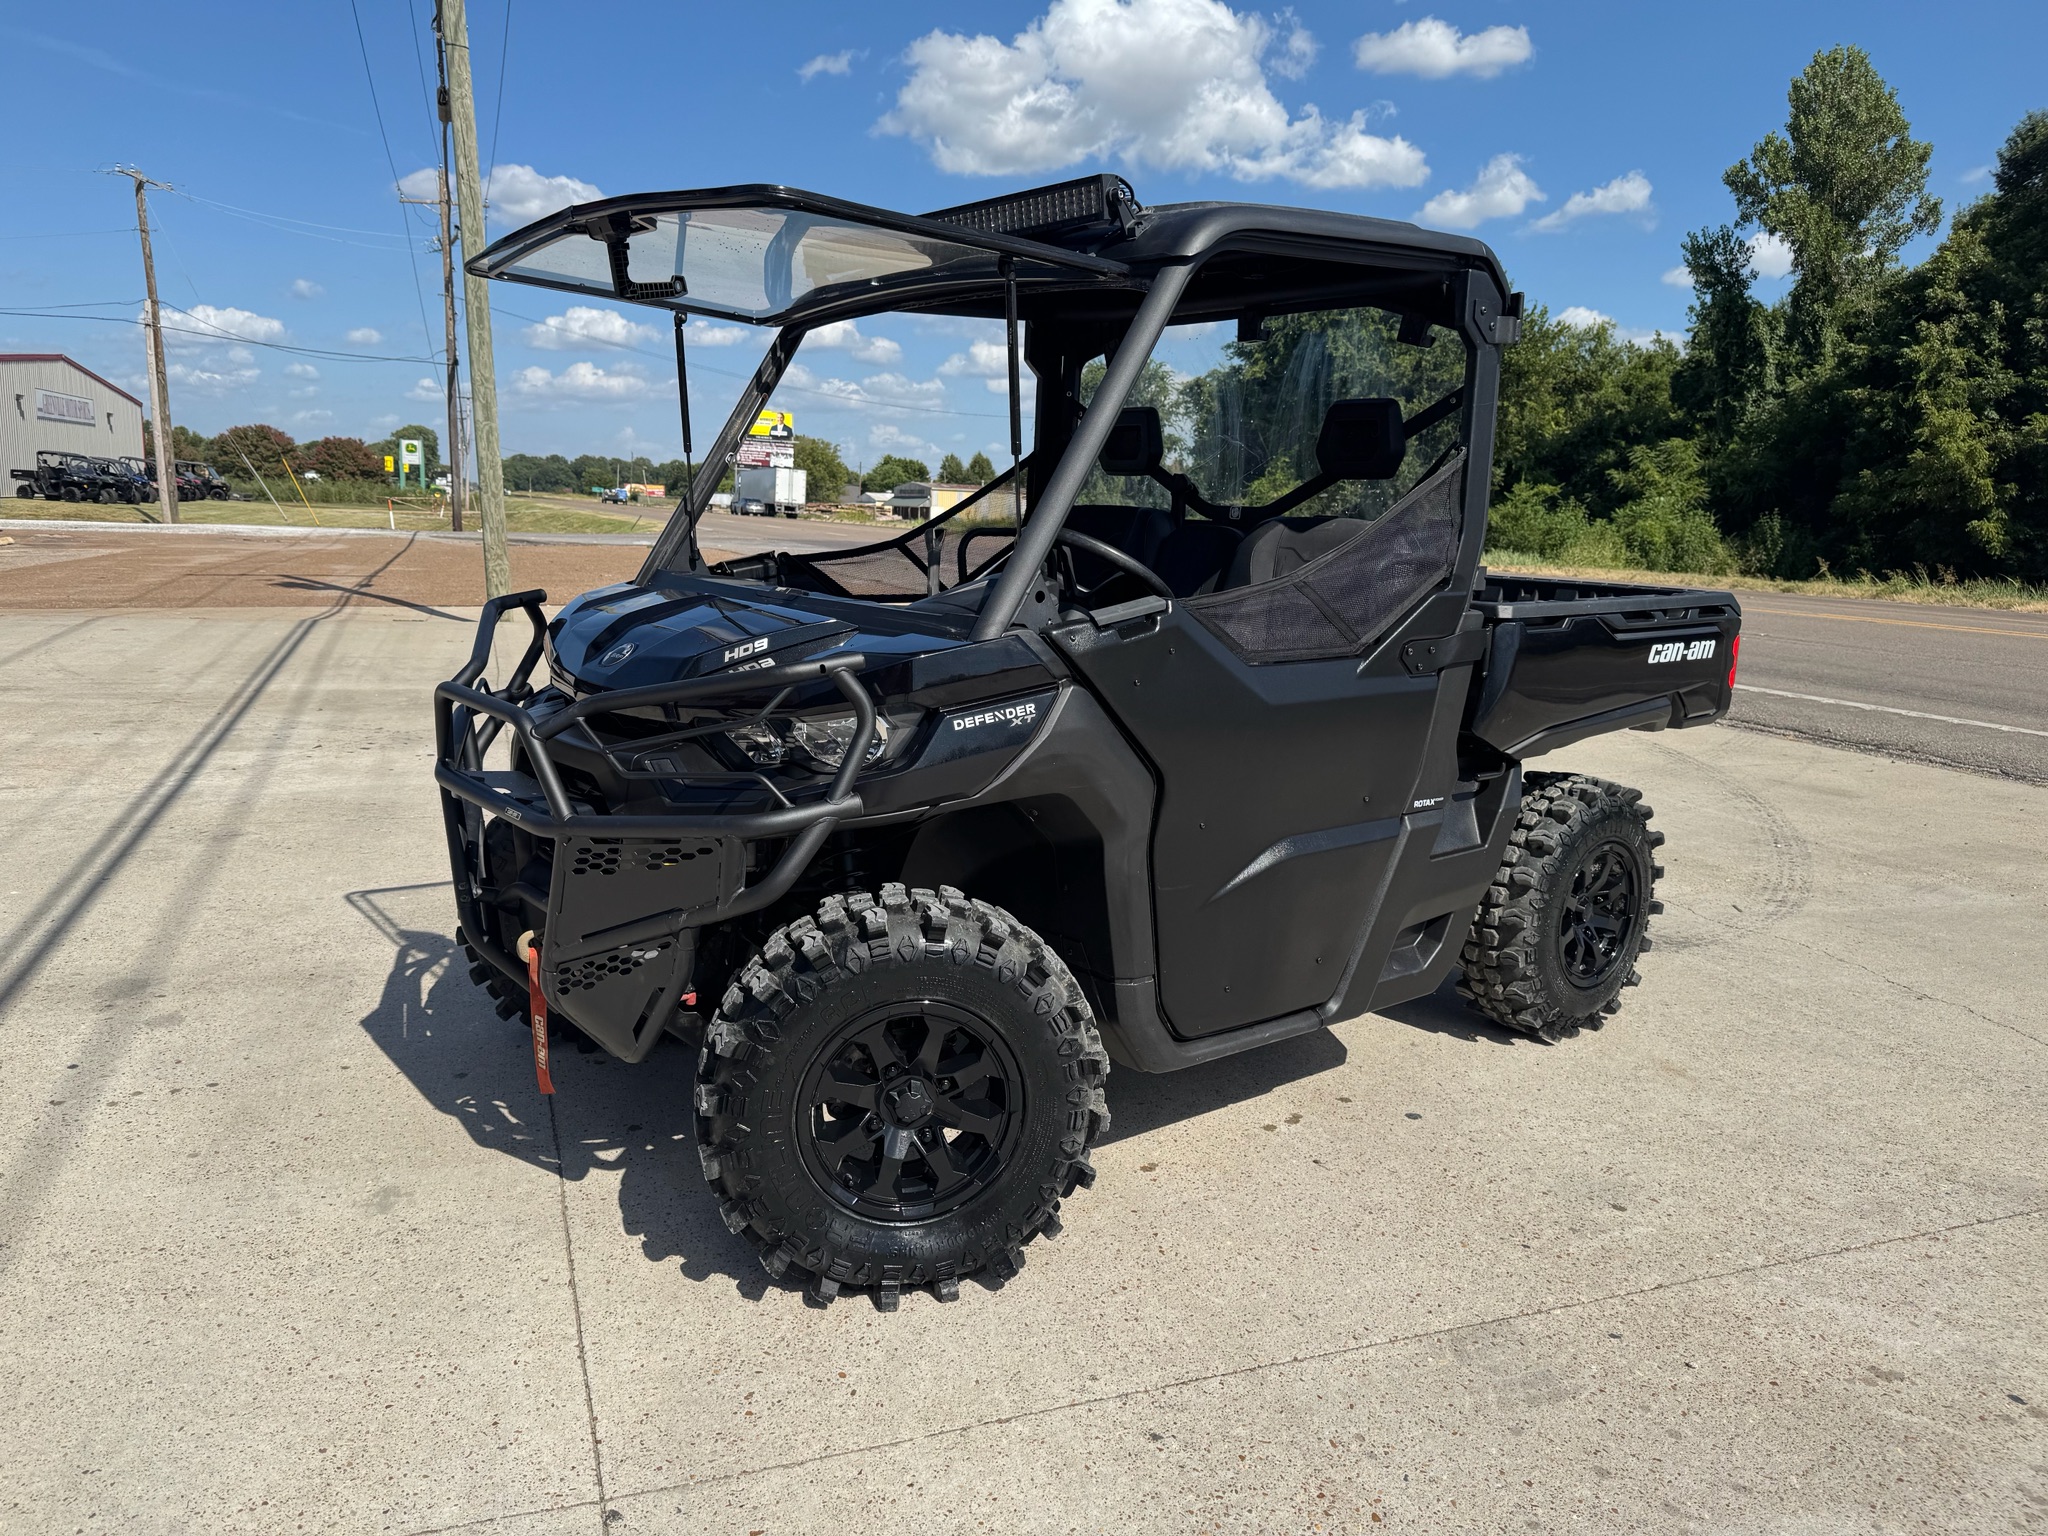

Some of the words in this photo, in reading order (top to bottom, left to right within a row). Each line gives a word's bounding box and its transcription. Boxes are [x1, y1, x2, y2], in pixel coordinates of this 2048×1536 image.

[724, 637, 769, 663] HD9
[1647, 639, 1716, 665] can-am
[952, 703, 1037, 732] DEFENDER
[1009, 714, 1037, 728] XT
[1413, 799, 1435, 808] ROTAX
[534, 1015, 546, 1070] can-am
